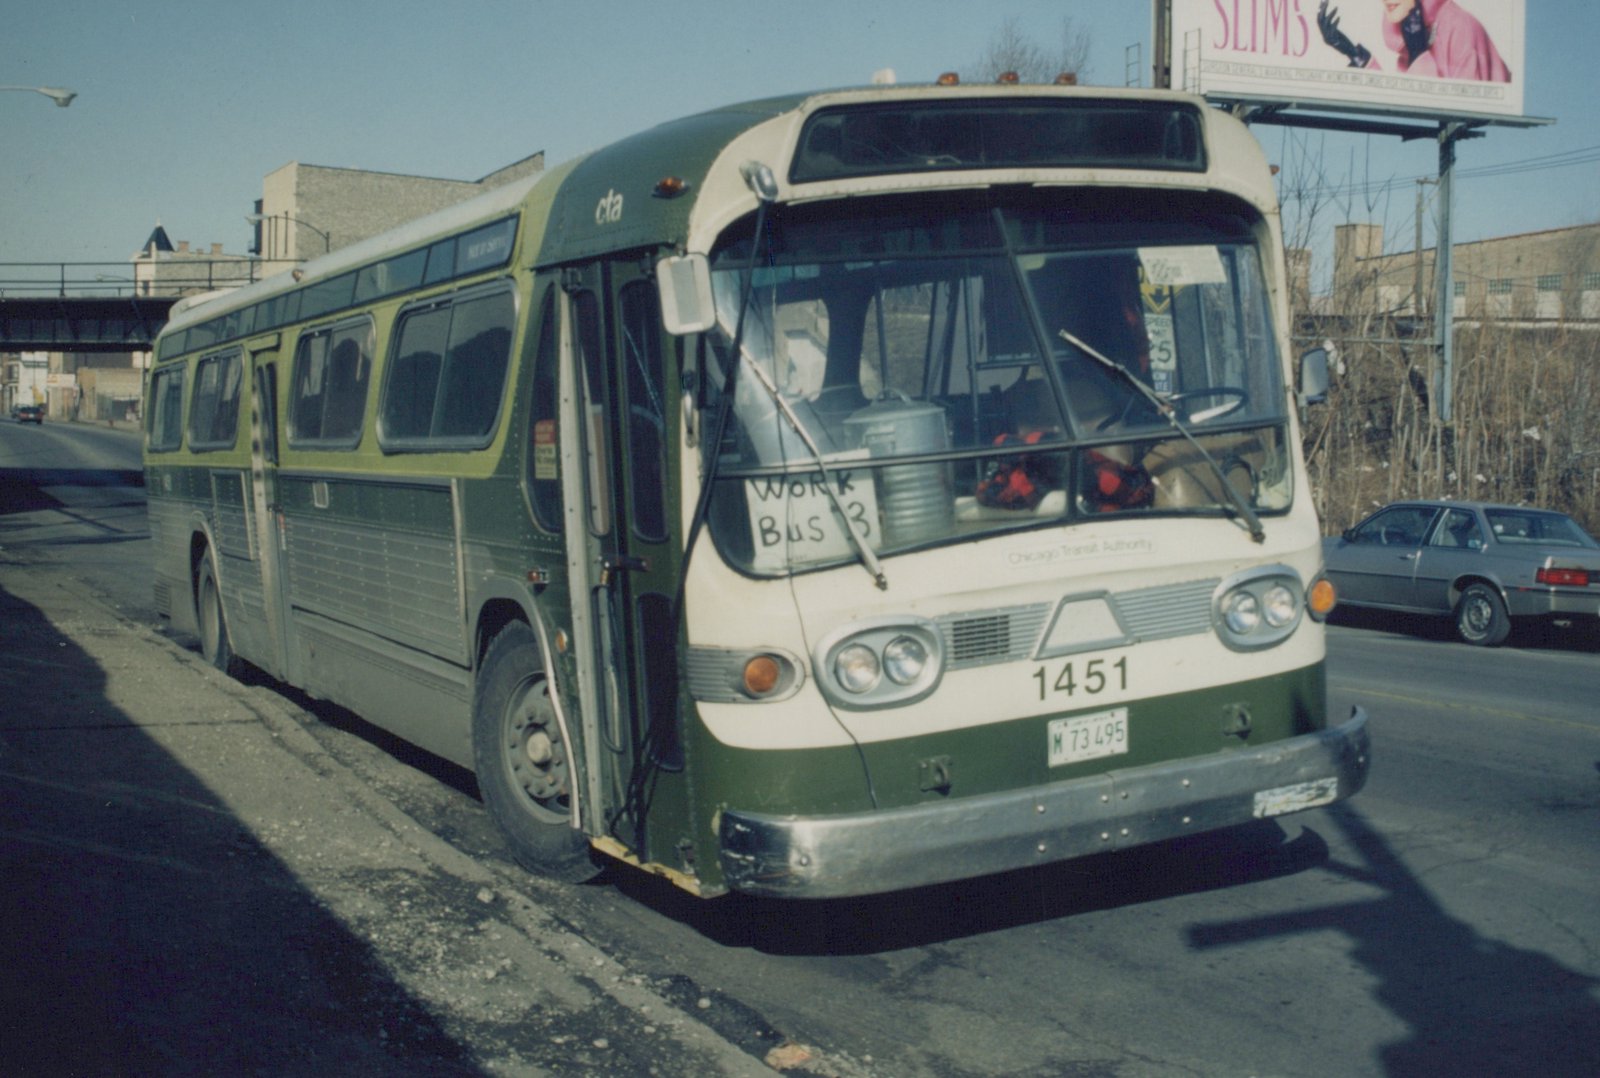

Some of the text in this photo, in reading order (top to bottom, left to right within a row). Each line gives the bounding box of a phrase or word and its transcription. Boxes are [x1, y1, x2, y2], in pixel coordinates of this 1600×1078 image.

[1213, 0, 1310, 58] SLIMS
[595, 187, 624, 225] cta
[847, 501, 871, 538] 3
[1032, 656, 1127, 701] 1451
